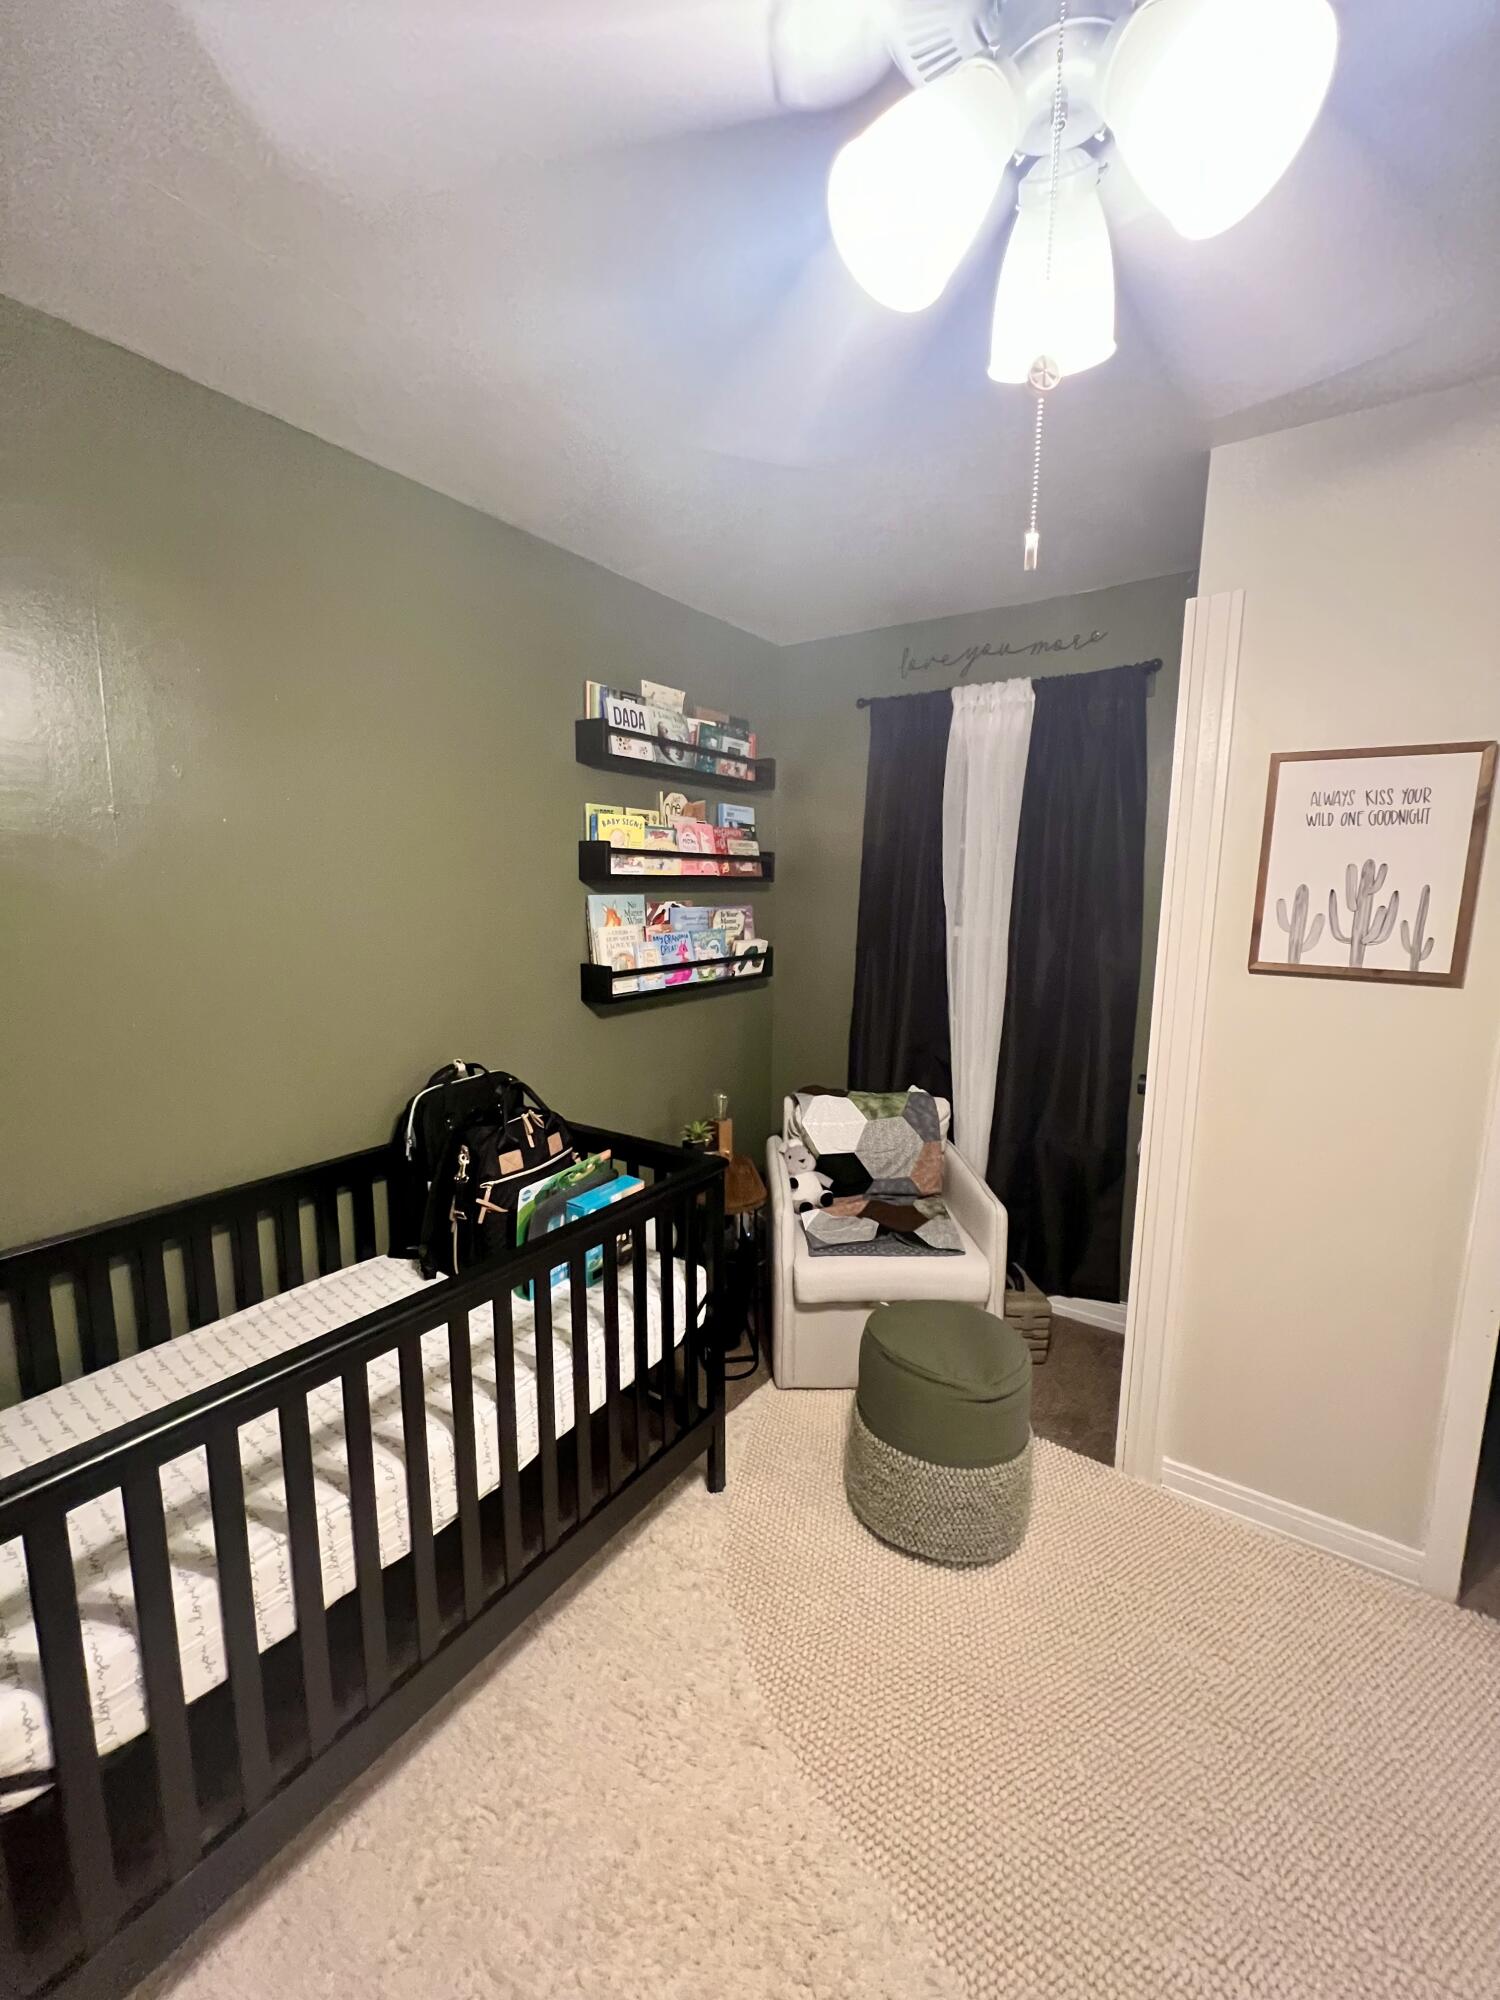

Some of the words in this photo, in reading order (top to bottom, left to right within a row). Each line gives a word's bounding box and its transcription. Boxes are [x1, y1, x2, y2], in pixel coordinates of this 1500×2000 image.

[613, 706, 646, 730] DADA
[1310, 789, 1356, 807] ALWAYS
[1365, 788, 1394, 806] KISS
[1401, 787, 1432, 805] YOUR
[602, 818, 620, 827] BABY
[622, 818, 643, 830] SIGNS
[1306, 812, 1334, 826] WILD
[1340, 811, 1365, 826] ONE
[1368, 807, 1432, 826] GOODNIGHT
